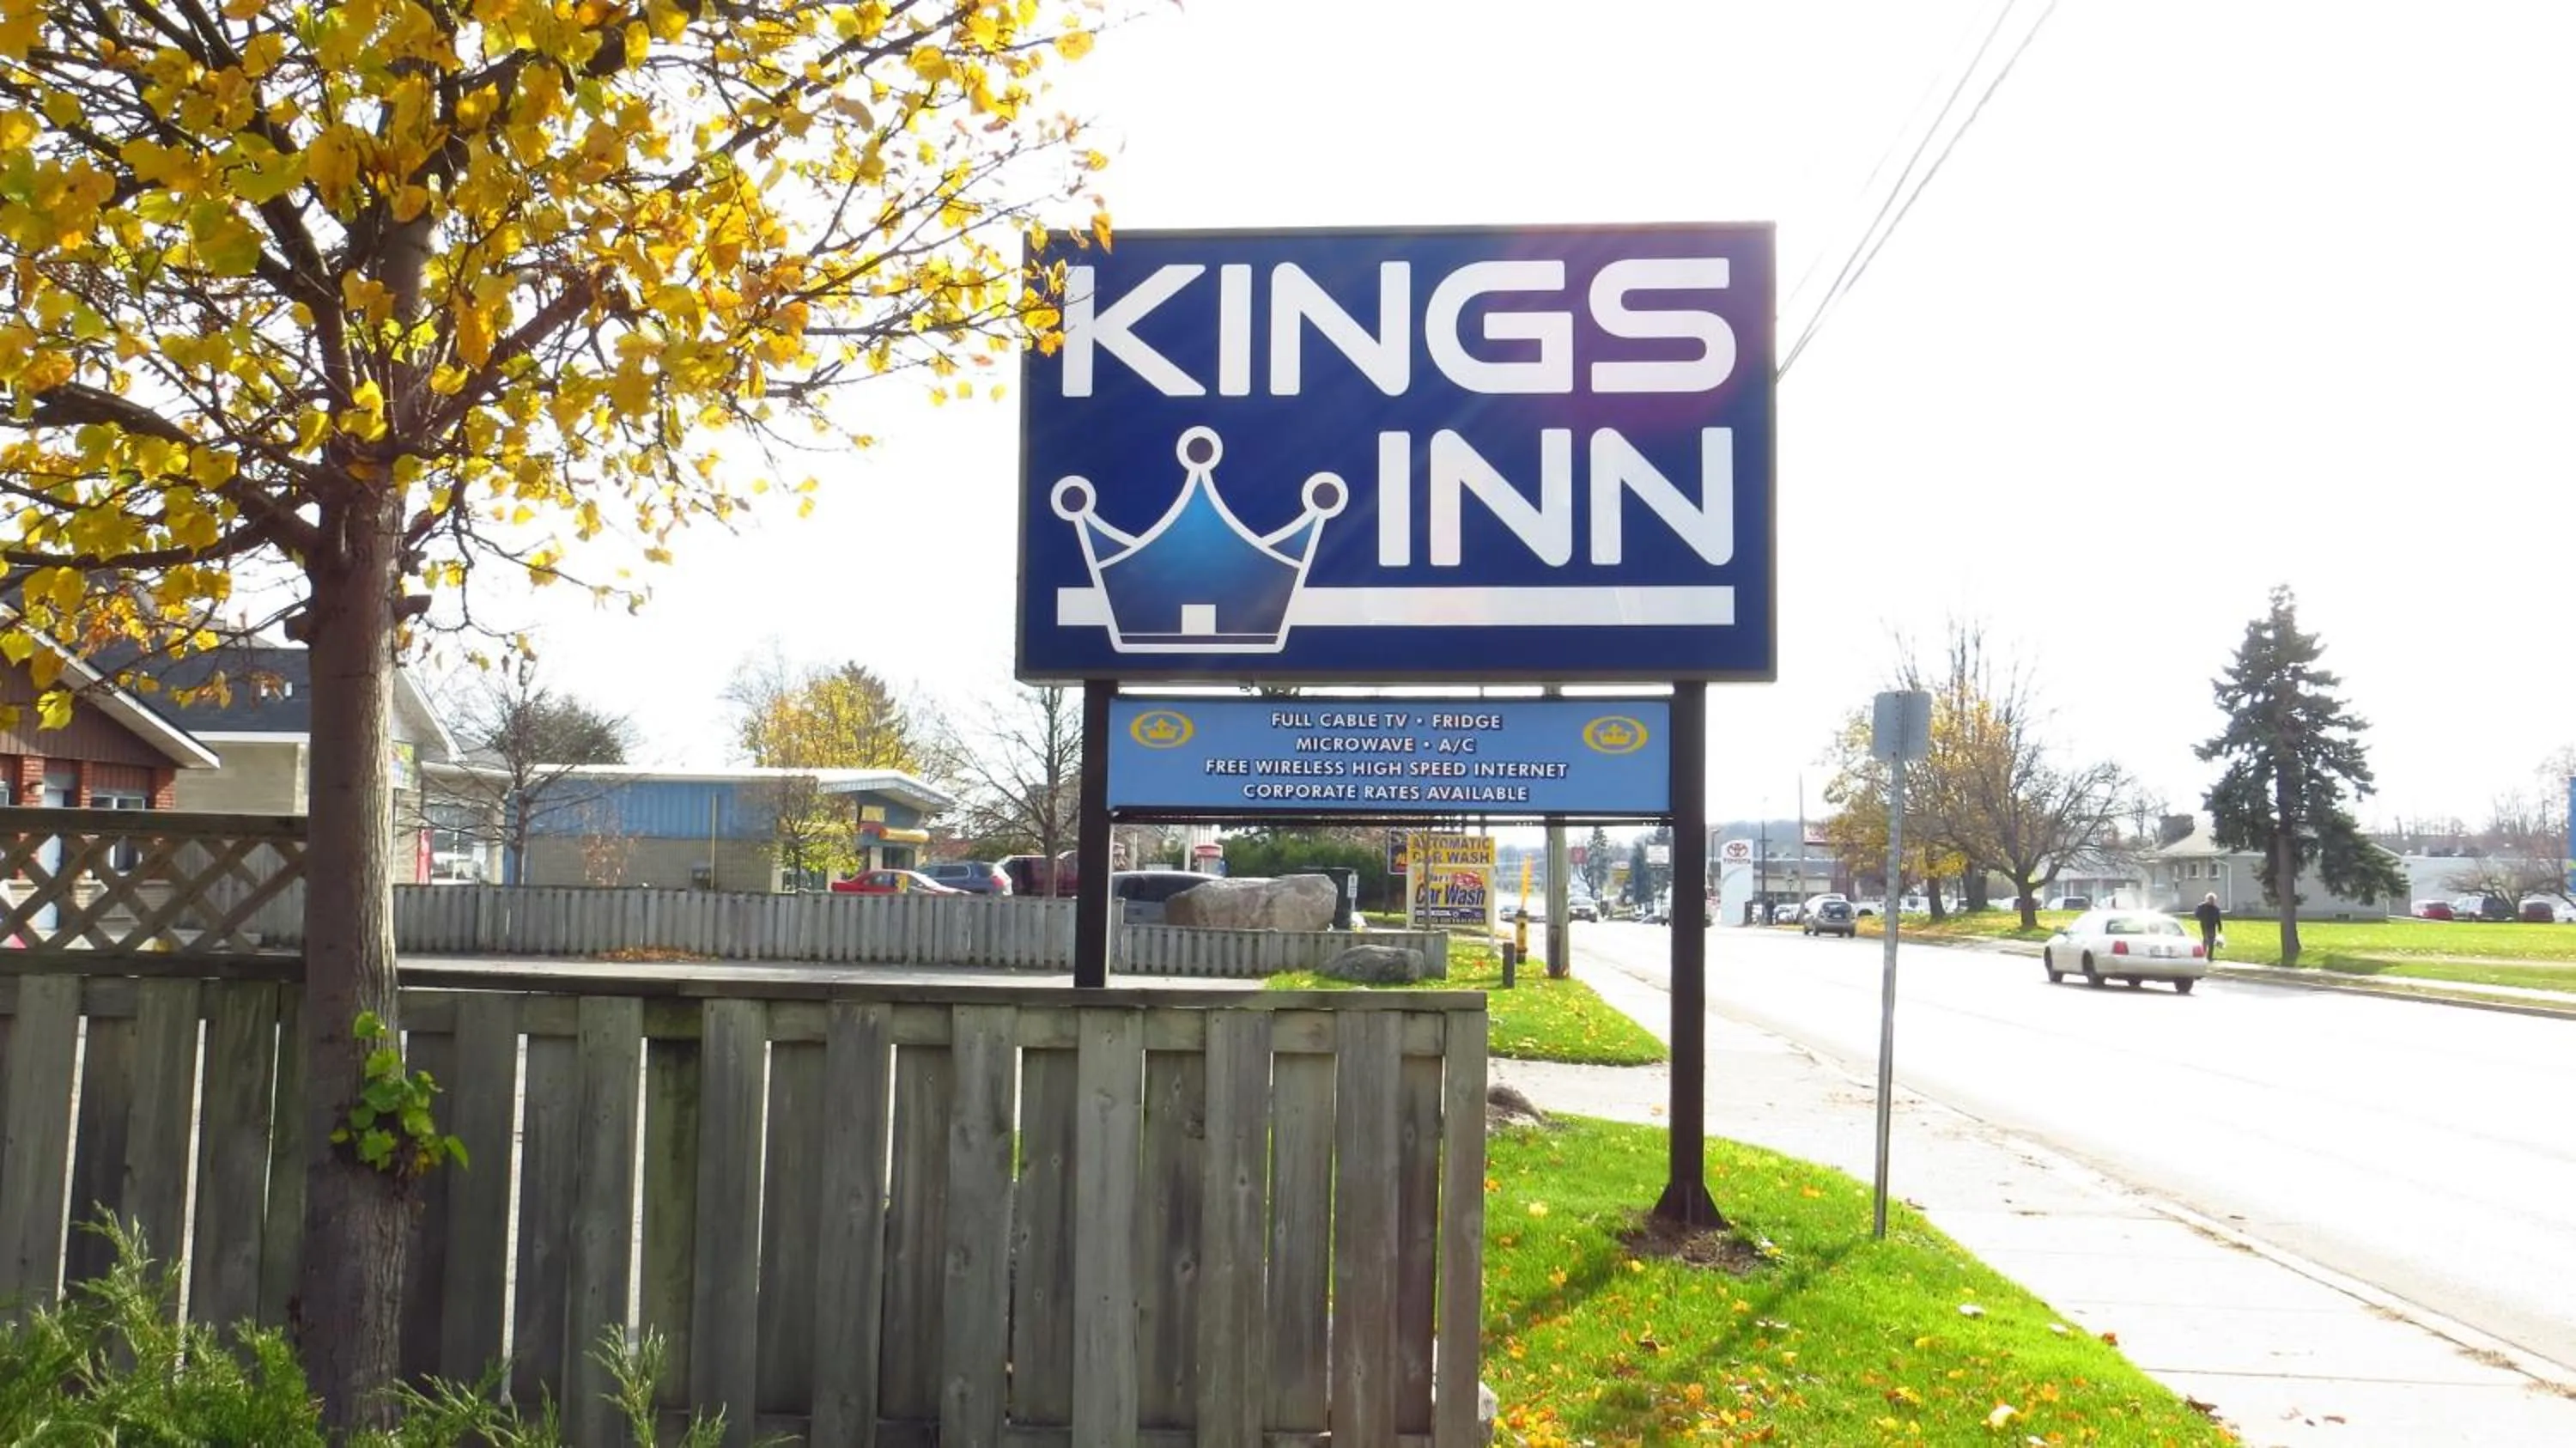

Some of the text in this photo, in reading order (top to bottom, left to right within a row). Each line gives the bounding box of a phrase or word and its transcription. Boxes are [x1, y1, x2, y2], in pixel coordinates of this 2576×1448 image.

[1061, 258, 1737, 397] KINGS
[1378, 428, 1734, 567] INN
[1272, 713, 1500, 729] FULL CABLE TV FRIDGE
[1296, 737, 1475, 753] MICROWAVE A/C
[1206, 759, 1568, 777] FREE WIRELESS HIGH SPEED INTERNET
[1243, 783, 1528, 800] CORPORATE RATES AVAILABLE
[1446, 851, 1490, 864] WASH
[1445, 882, 1486, 905] Wash
